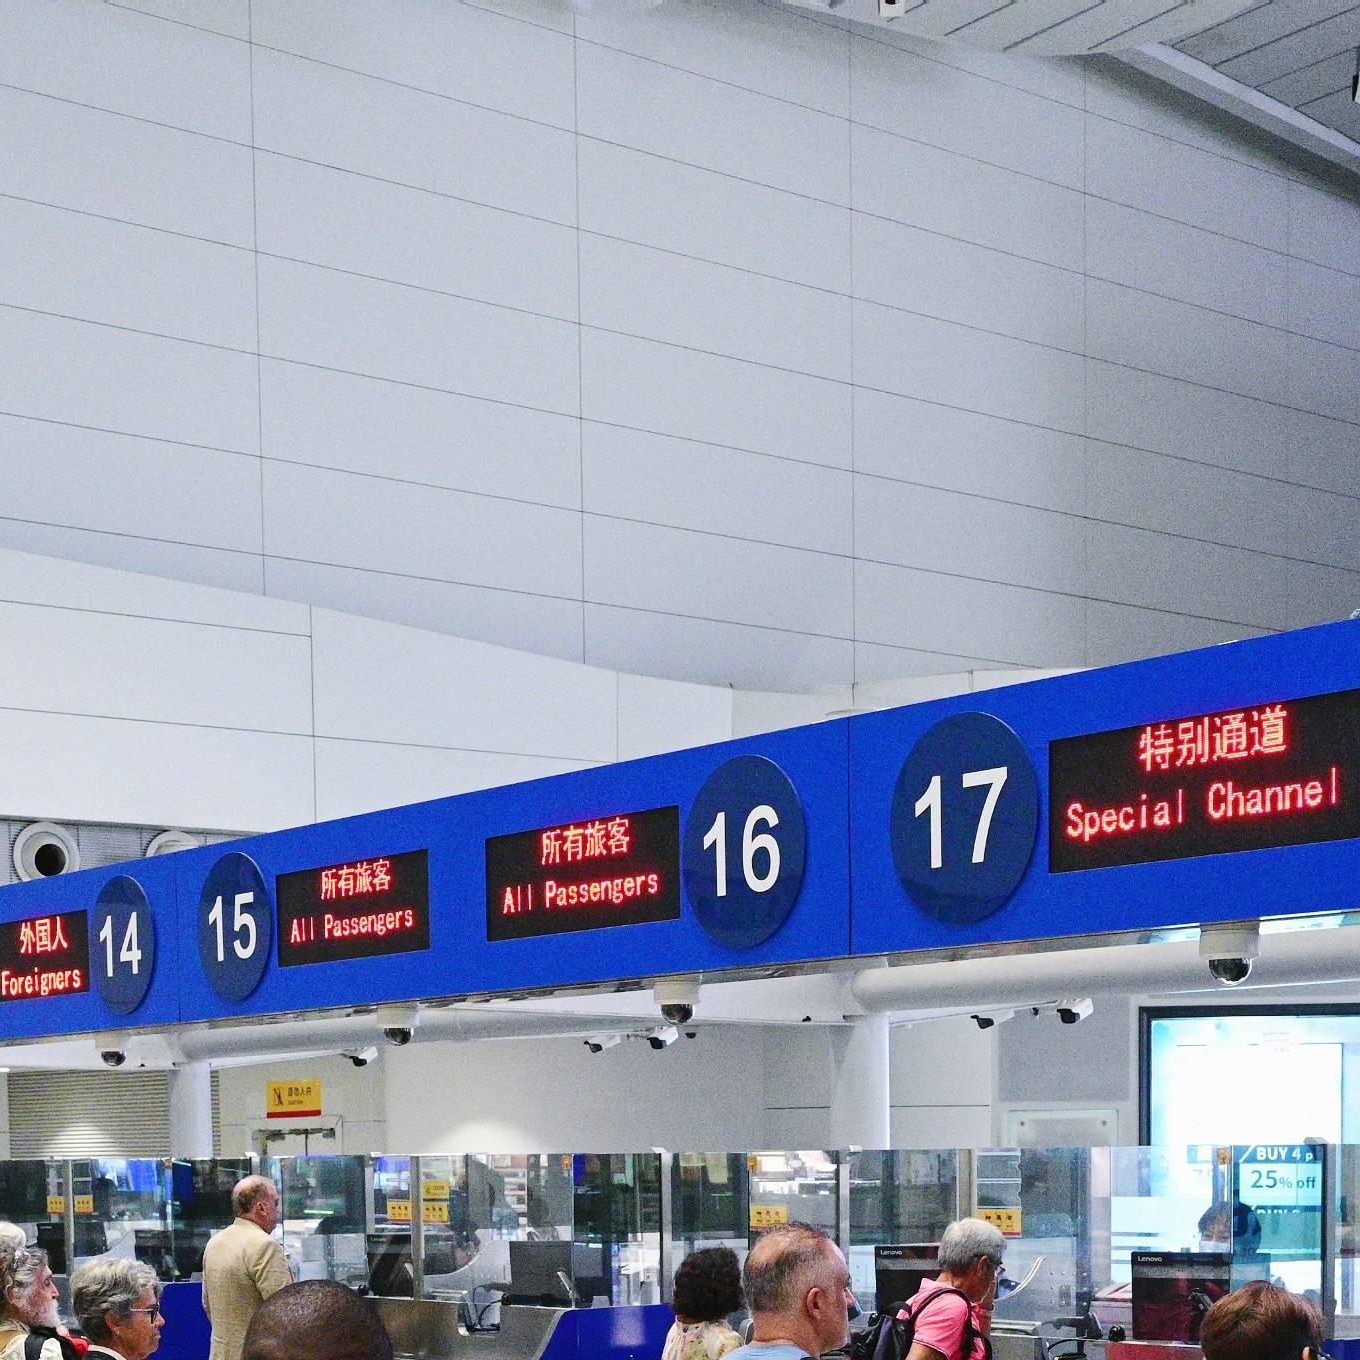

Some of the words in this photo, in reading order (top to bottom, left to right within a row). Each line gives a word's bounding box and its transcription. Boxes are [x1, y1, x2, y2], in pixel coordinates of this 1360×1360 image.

[1140, 704, 1288, 771] 特别通道
[914, 766, 1008, 869] 17
[1066, 788, 1184, 841] Special
[1208, 767, 1339, 820] Channel
[541, 817, 630, 866] 所有旅客
[703, 804, 781, 897] 16
[321, 859, 391, 900] 所有旅客
[503, 883, 532, 915] All
[545, 873, 659, 910] Passengers
[19, 916, 68, 955] 外国人
[99, 911, 142, 978] 14
[208, 891, 257, 962] 15
[291, 917, 314, 944] All
[324, 908, 413, 939] Passengers
[1, 967, 82, 996] Foreigners
[1257, 1147, 1288, 1160] BUY
[1292, 1147, 1301, 1160] 4
[1251, 1170, 1292, 1188] 25%
[1297, 1176, 1316, 1188] off
